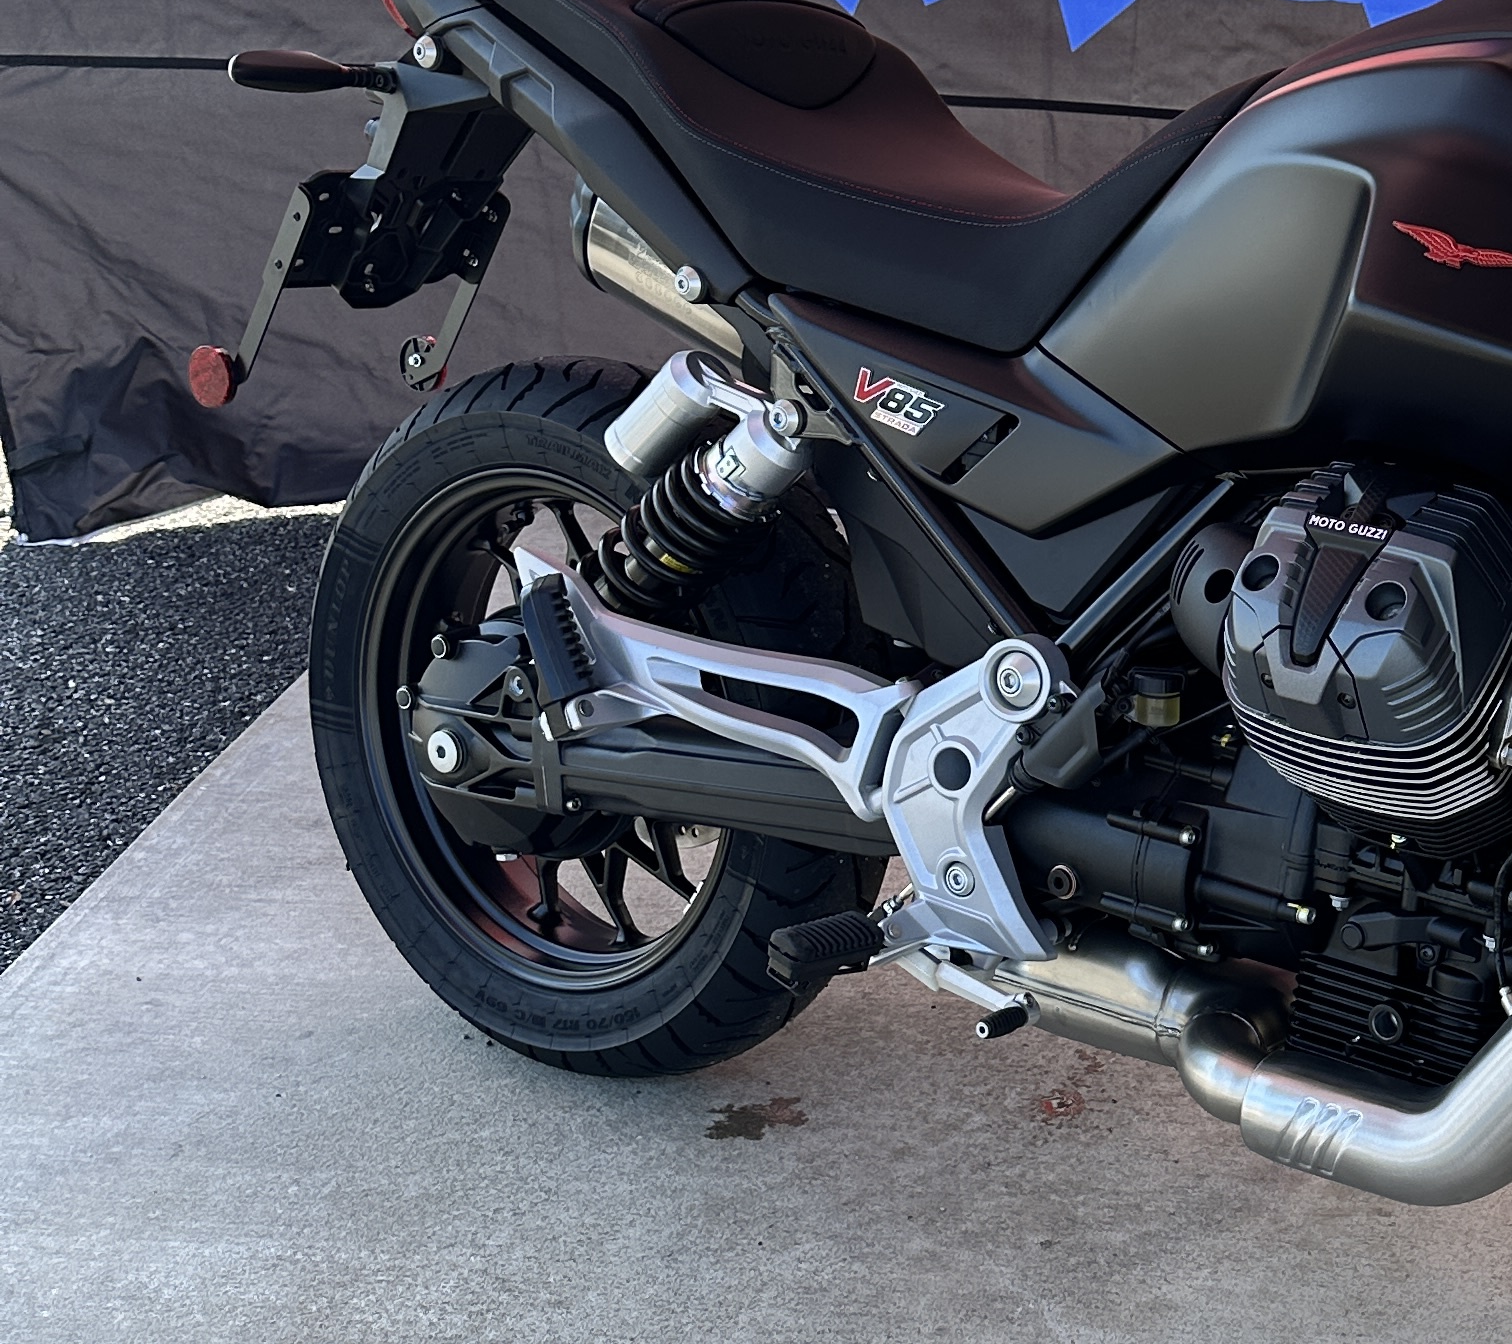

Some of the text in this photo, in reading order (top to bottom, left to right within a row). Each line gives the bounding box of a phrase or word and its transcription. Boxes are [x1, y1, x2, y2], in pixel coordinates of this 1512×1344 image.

[854, 367, 945, 426] V85
[872, 412, 917, 434] STRADA
[1309, 514, 1388, 541] MOTO GUZZI
